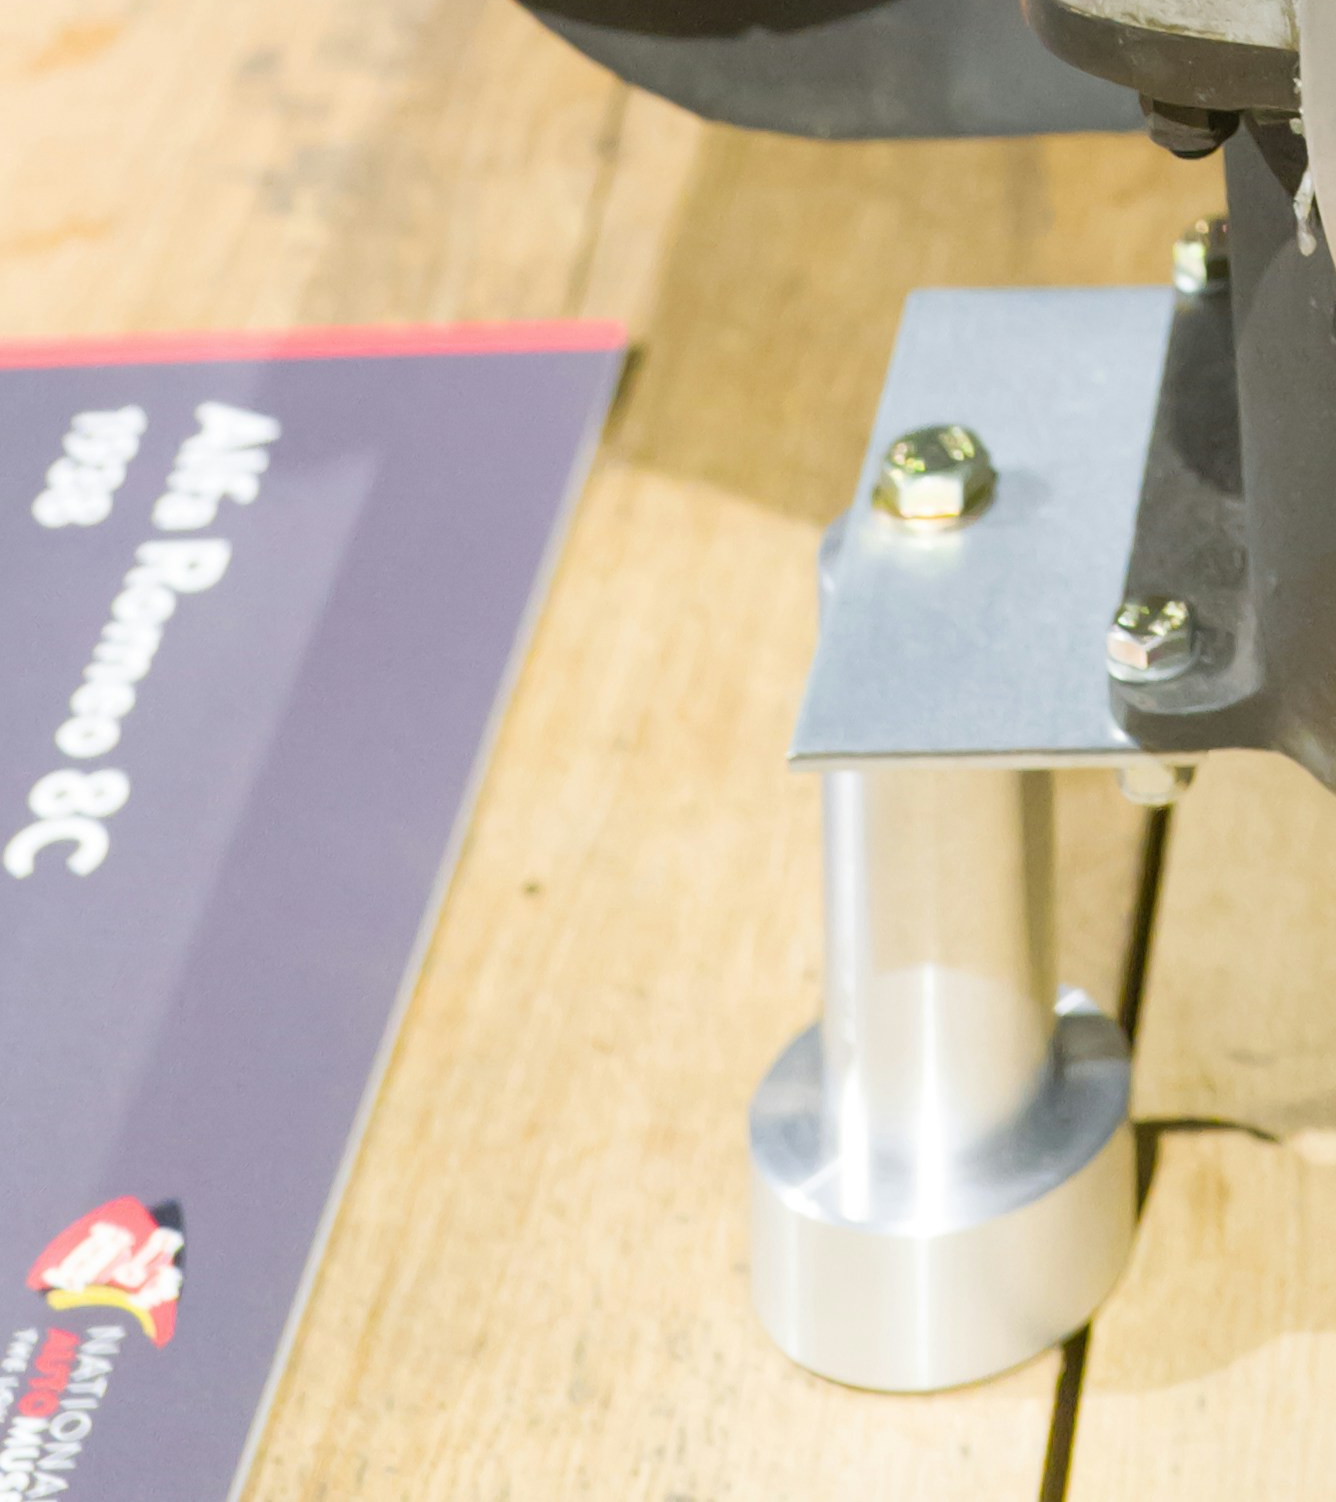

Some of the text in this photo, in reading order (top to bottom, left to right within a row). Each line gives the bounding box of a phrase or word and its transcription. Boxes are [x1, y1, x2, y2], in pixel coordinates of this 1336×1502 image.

[2, 400, 282, 880] Alfa Romeo 8C
[23, 1325, 127, 1502] NATIONA
